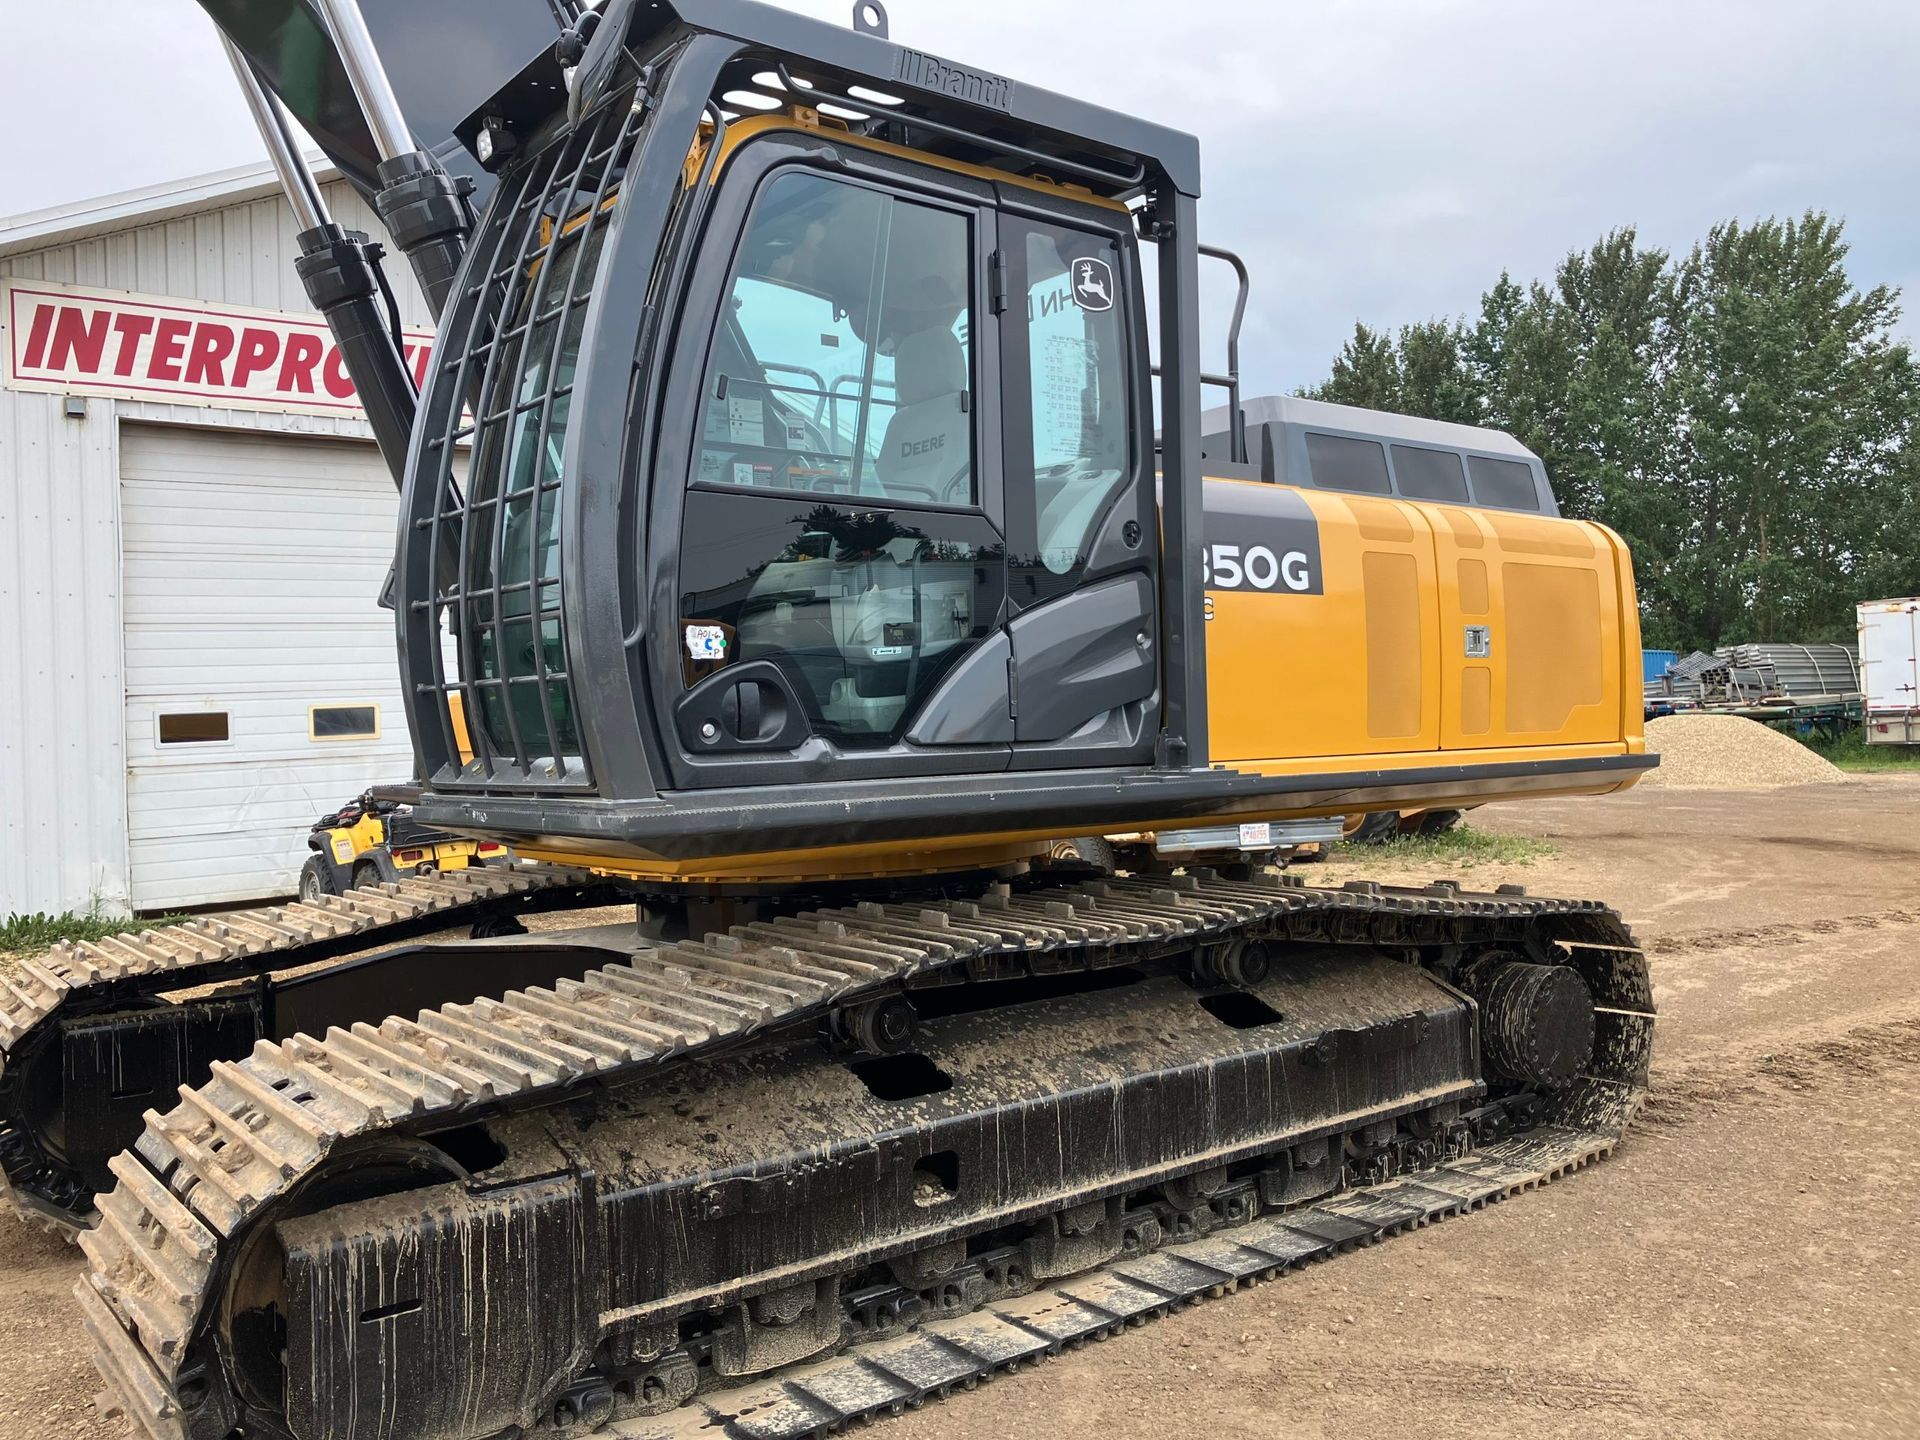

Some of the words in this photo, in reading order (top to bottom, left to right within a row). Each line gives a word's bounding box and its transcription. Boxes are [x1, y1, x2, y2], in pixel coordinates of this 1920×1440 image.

[924, 54, 1010, 108] Brandt
[22, 303, 432, 399] INTERPROI
[901, 434, 945, 459] DEERE
